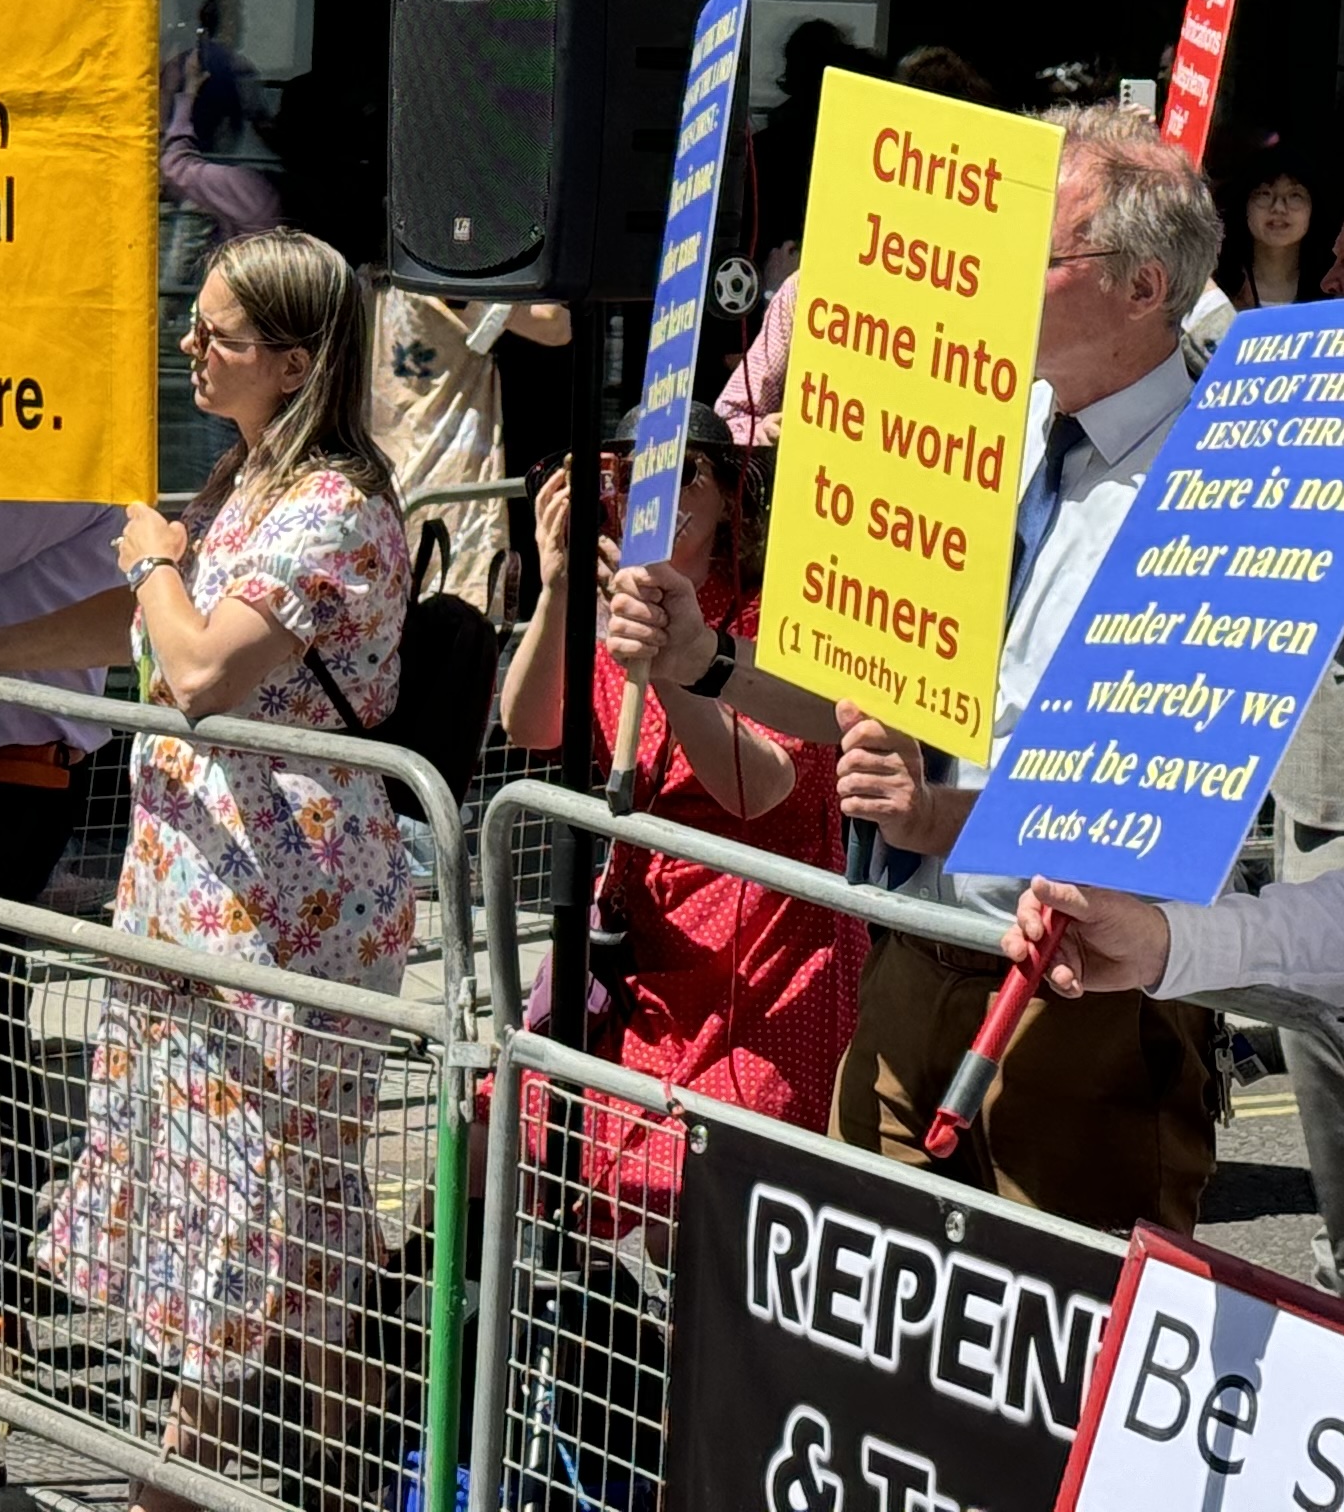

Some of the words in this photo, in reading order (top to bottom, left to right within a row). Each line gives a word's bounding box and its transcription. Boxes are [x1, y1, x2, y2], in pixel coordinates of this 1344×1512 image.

[872, 126, 1002, 215] Christ
[859, 212, 981, 300] Jesus
[807, 294, 915, 371] came
[930, 322, 1019, 404] into
[1196, 377, 1263, 411] SAYS
[1264, 374, 1306, 407] OF
[1235, 330, 1315, 367] WHAT
[799, 370, 865, 444] the
[880, 407, 1005, 495] world
[1195, 417, 1274, 453] JESUS
[814, 464, 855, 529] to
[867, 503, 968, 573] save
[1156, 468, 1254, 512] There
[1253, 466, 1291, 511] is
[1135, 534, 1227, 580] other
[1227, 546, 1335, 584] name
[802, 554, 960, 661] sinners
[1084, 601, 1186, 647] under
[1181, 601, 1320, 656] heaven
[777, 615, 802, 657] (1
[810, 628, 909, 706] Timothy
[916, 674, 983, 740] 1:15)
[1086, 669, 1238, 733] whereby
[1241, 689, 1297, 731] we
[1008, 738, 1094, 784] must
[1093, 737, 1139, 788] be
[1139, 754, 1261, 803] saved
[1017, 805, 1085, 849] (Acts
[1086, 814, 1164, 861] 4:12)
[746, 1182, 1111, 1444] REPEN
[1122, 1310, 1260, 1478] Be
[766, 1404, 844, 1512] &
